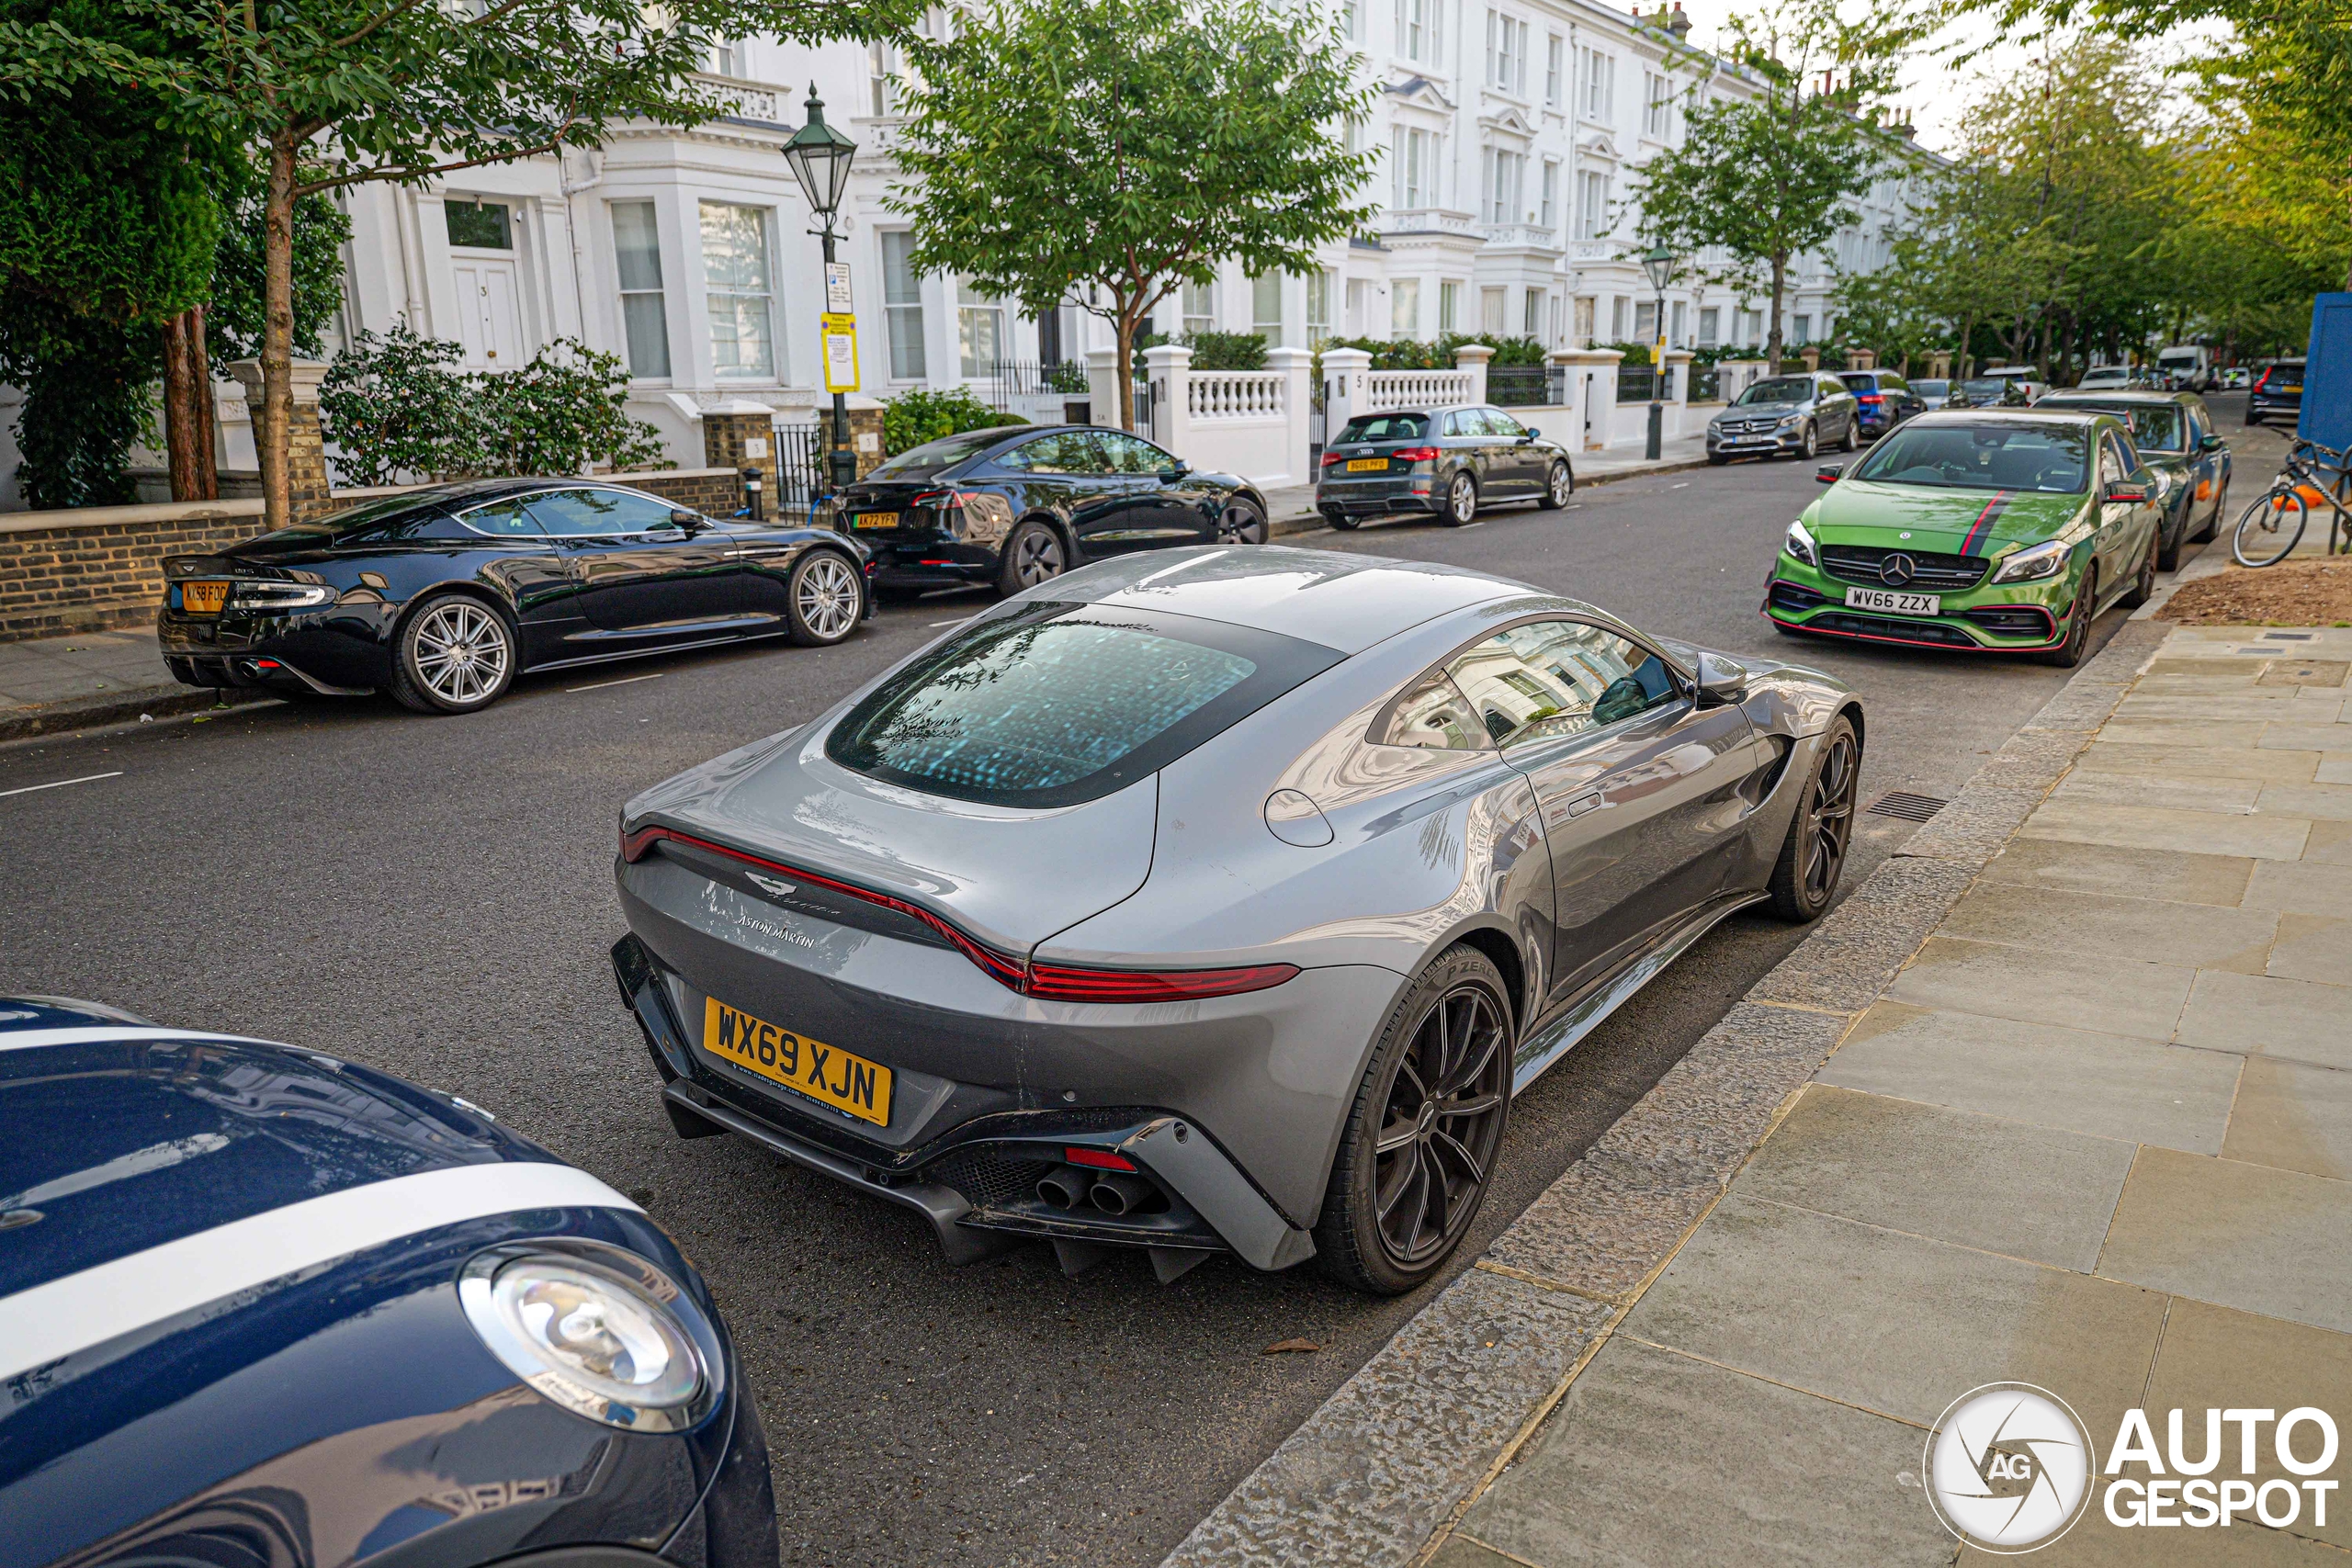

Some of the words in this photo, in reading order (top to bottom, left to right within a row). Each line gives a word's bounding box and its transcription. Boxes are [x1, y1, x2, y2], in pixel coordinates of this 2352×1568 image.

[481, 286, 487, 297] 3
[1357, 375, 1362, 389] 5
[858, 514, 879, 525] AK72
[881, 513, 897, 525] YFN
[1853, 590, 1894, 607] WV66
[1898, 595, 1932, 612] ZZX
[738, 915, 773, 935] ASTON
[772, 928, 815, 949] MARTIN
[1446, 964, 1457, 980] P
[1460, 961, 1495, 979] ZERO
[718, 1005, 799, 1077] WX69
[808, 1043, 876, 1111] XJN
[739, 1067, 800, 1097] www.sladesgarage.com
